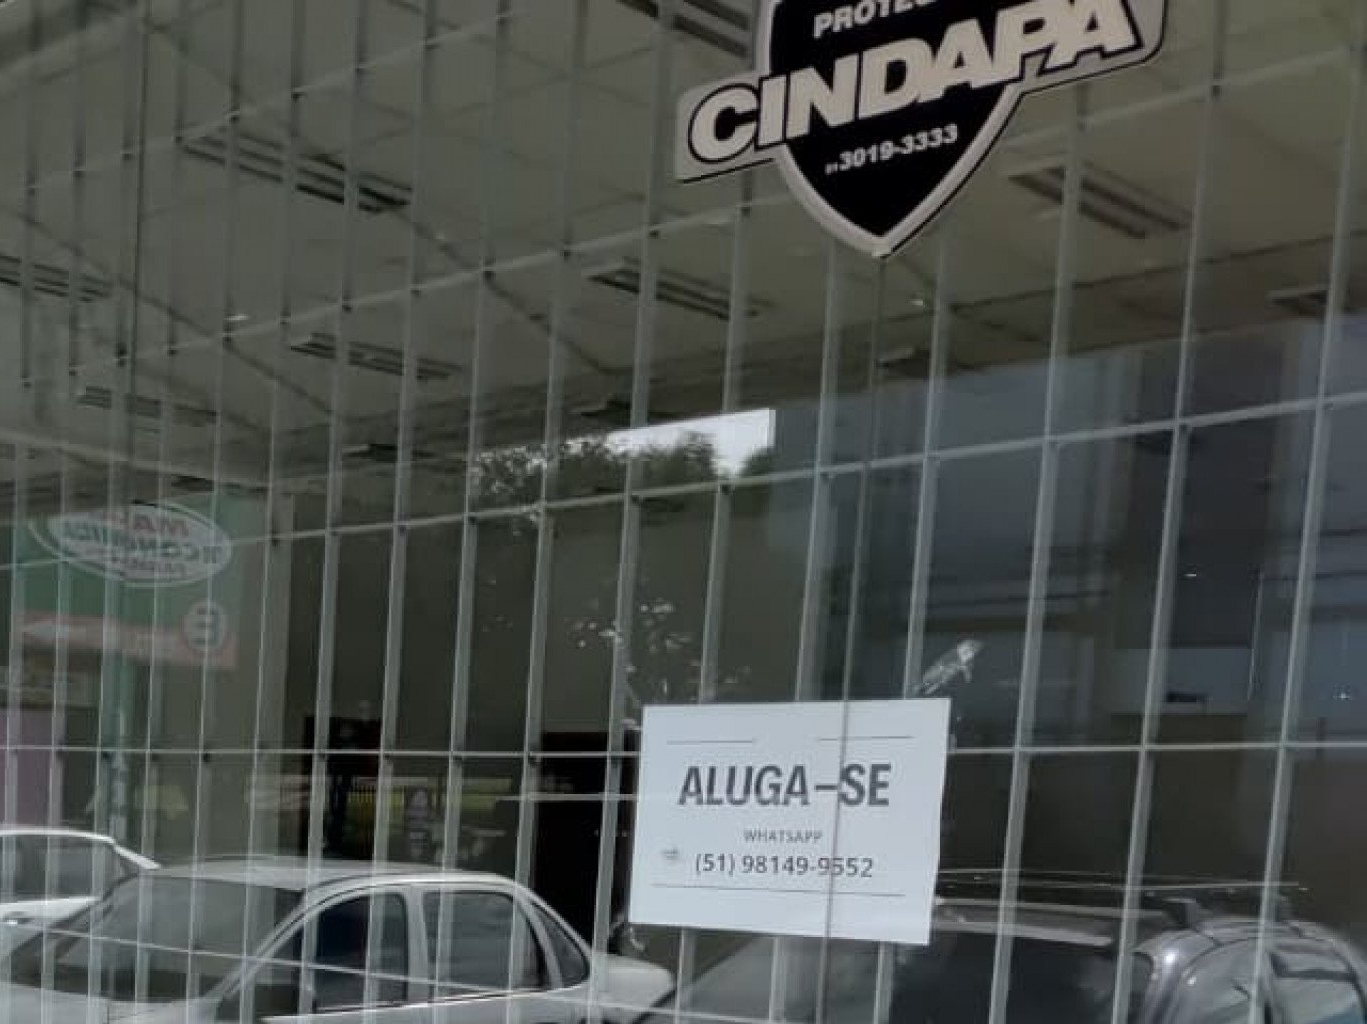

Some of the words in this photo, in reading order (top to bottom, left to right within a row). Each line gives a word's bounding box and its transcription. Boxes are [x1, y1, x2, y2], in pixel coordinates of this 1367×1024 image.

[687, 0, 1141, 162] CINDAPA
[678, 762, 891, 807] ALUGA-SE
[743, 829, 824, 844] WHATSAPP
[695, 853, 735, 877] (51)
[741, 855, 874, 879] 98149-9552
